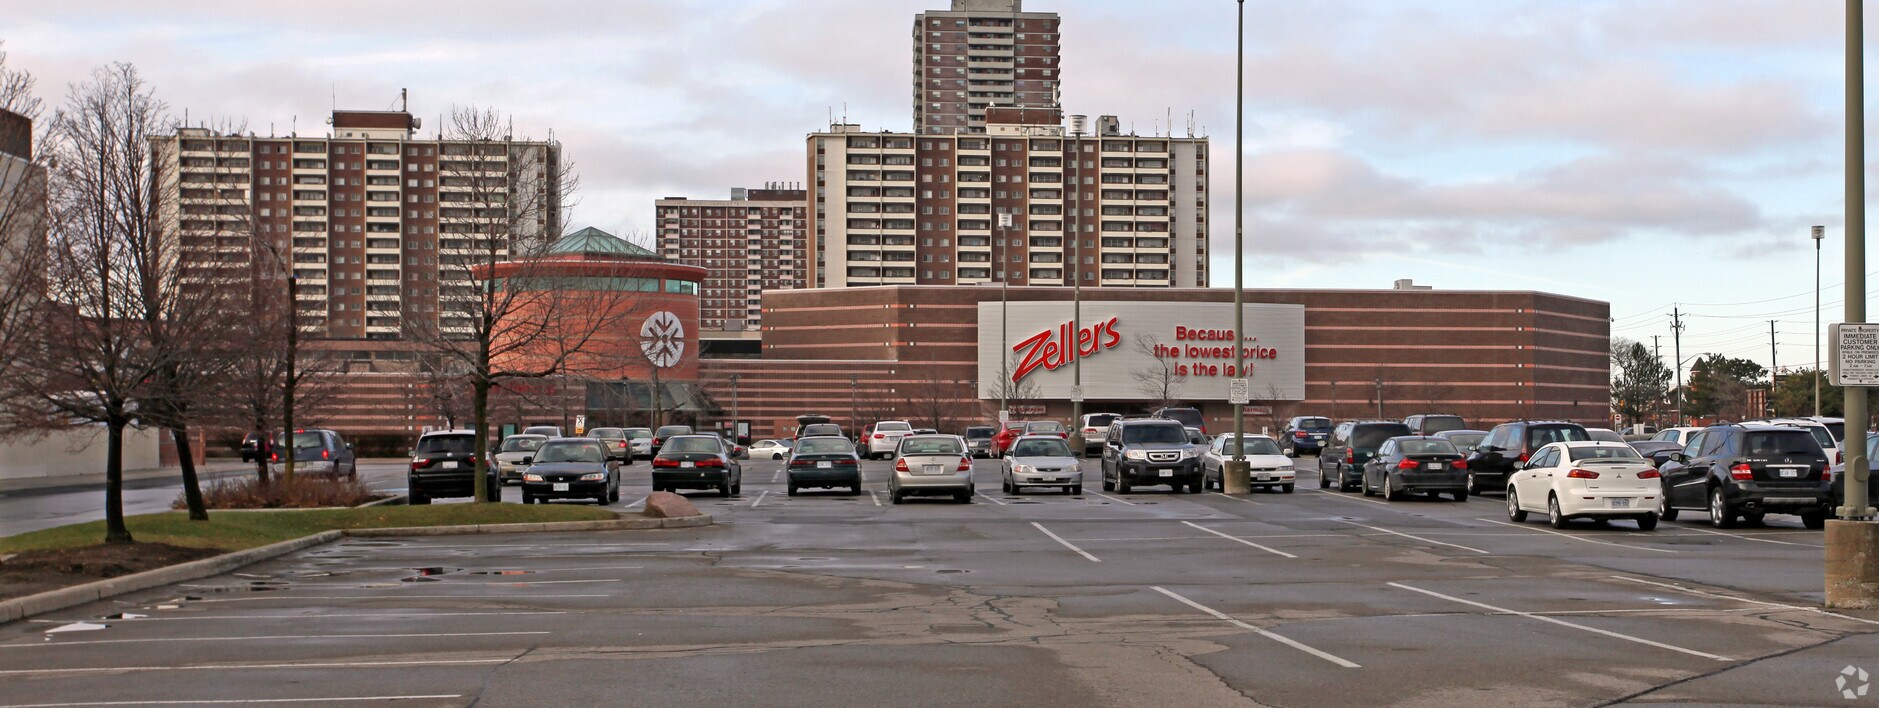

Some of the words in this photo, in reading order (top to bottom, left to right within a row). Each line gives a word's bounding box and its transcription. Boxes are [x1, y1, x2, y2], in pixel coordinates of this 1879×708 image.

[1175, 326, 1257, 341] Becaus...
[1012, 316, 1121, 383] Zellers
[1153, 344, 1180, 358] the
[1185, 344, 1236, 359] lowest
[1174, 362, 1188, 376] is
[1192, 362, 1218, 376] the
